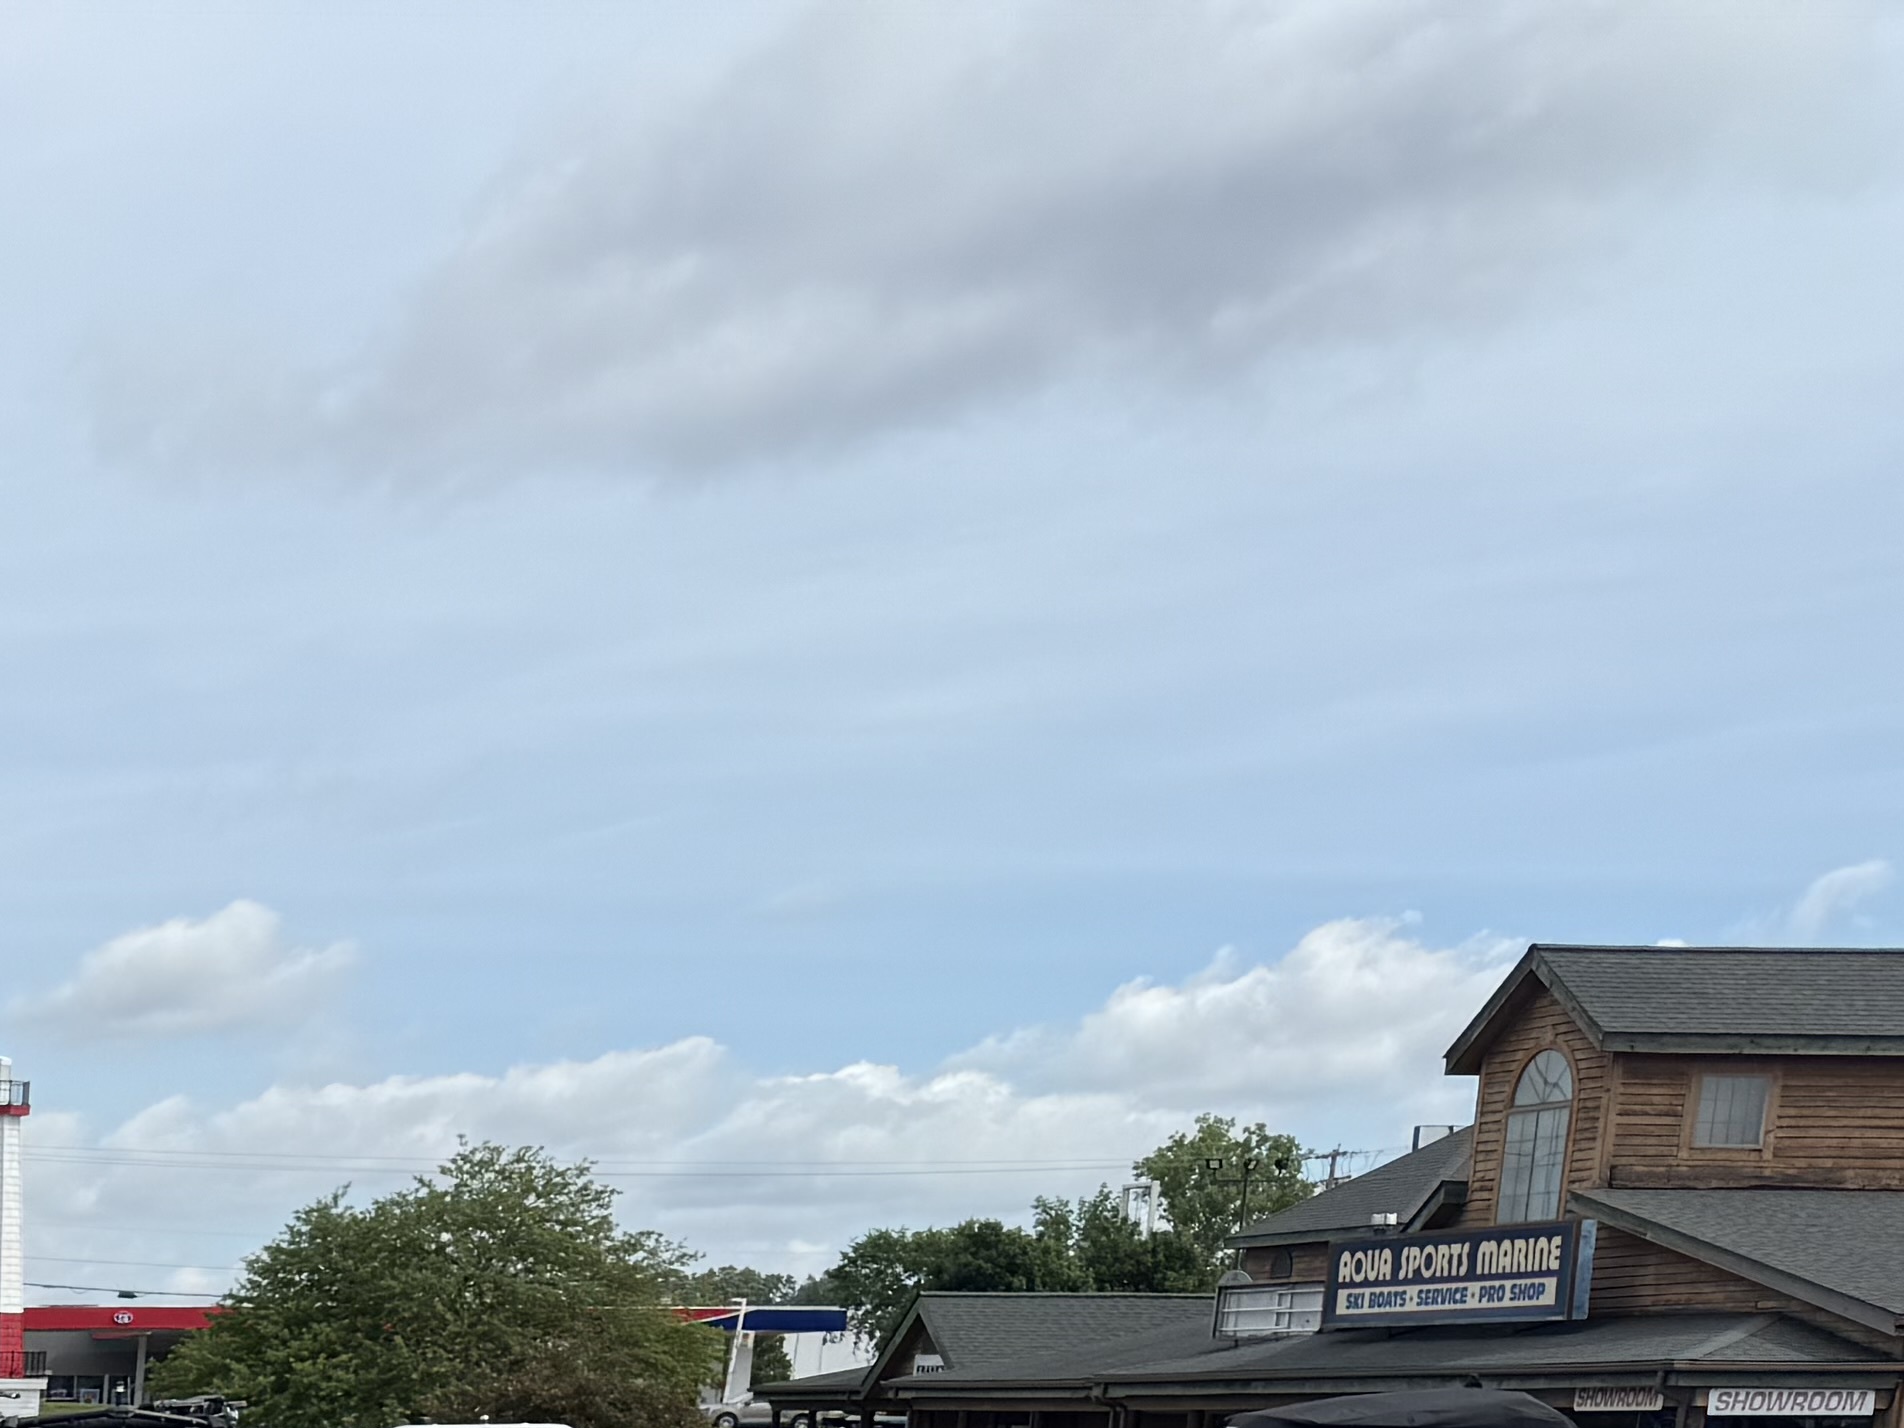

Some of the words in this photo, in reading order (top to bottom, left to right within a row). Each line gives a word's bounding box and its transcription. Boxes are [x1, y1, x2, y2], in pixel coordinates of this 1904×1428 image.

[1338, 1249, 1392, 1283] AQUA
[1399, 1242, 1470, 1281] SPORTS
[1476, 1235, 1562, 1275] MARINE
[1345, 1290, 1364, 1310] SKI
[1368, 1289, 1407, 1309] BOATS
[1416, 1286, 1468, 1307] SERVICE
[1478, 1284, 1504, 1303] PRO
[1509, 1282, 1546, 1302] SHOP
[1575, 1386, 1658, 1409] SHOWROOM
[1714, 1390, 1868, 1413] SHOWROOM
